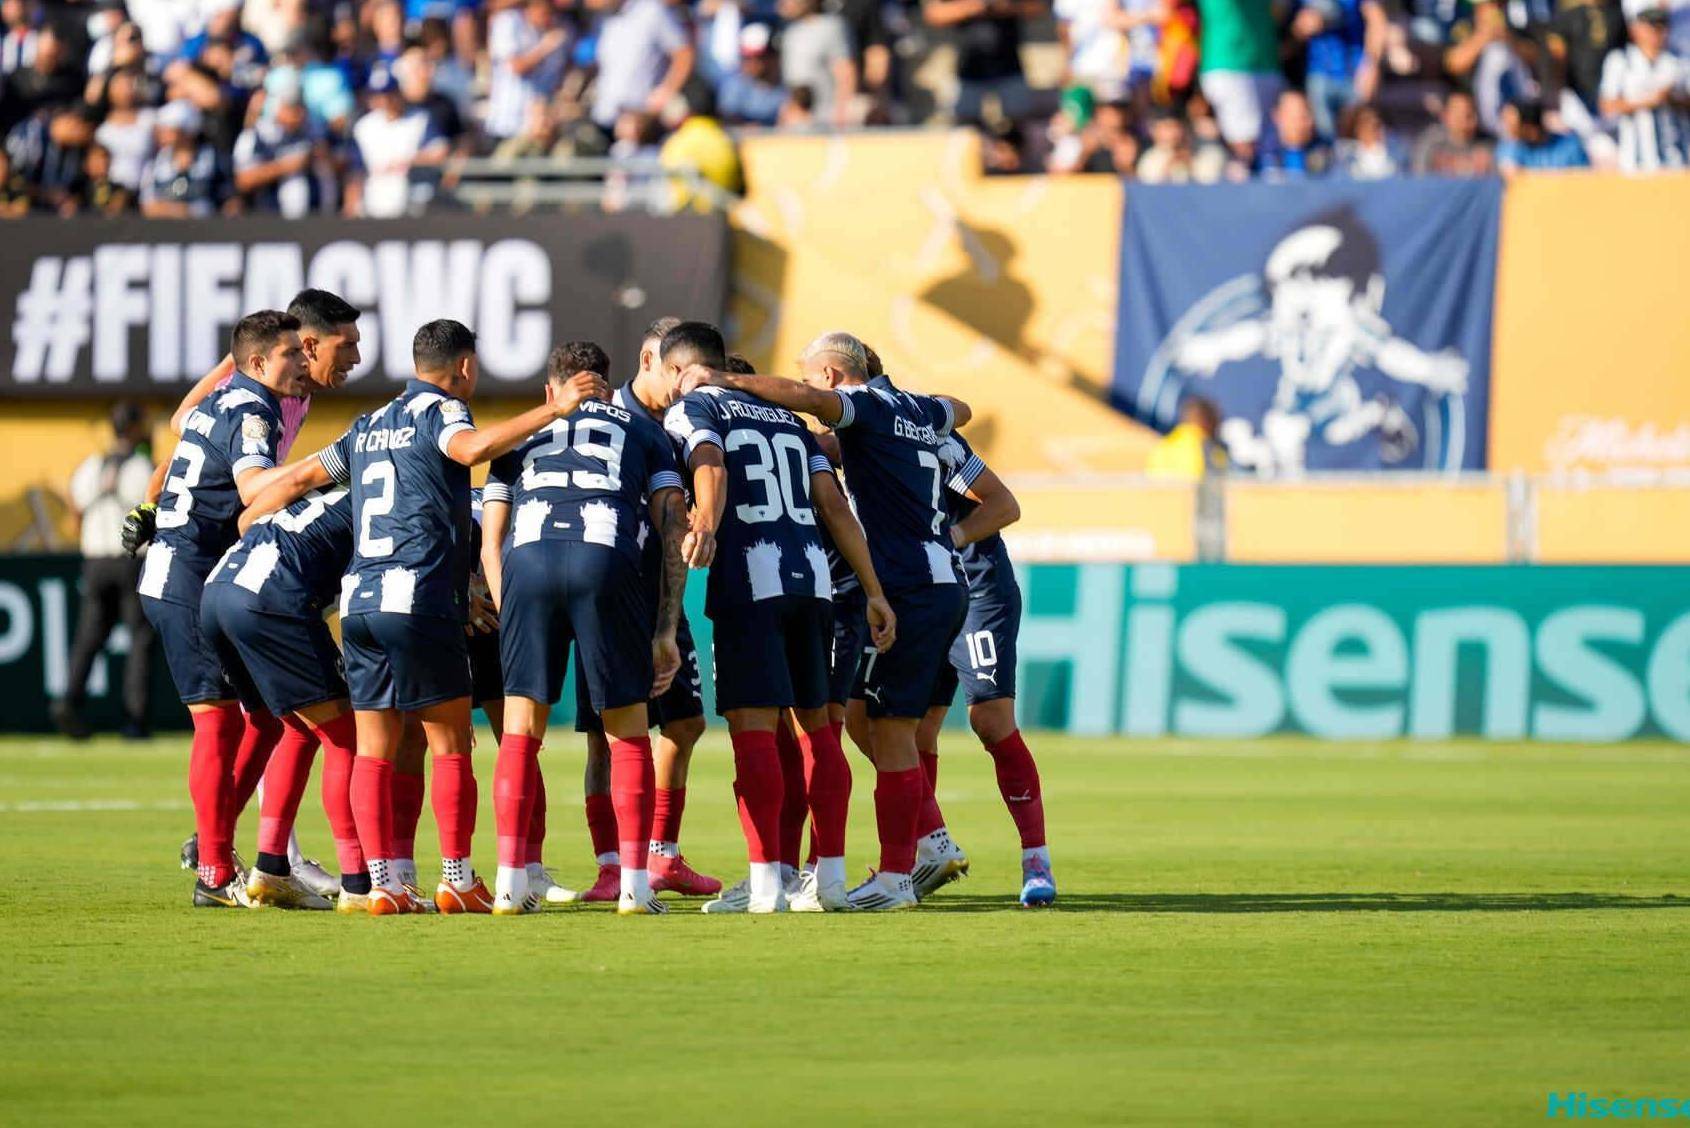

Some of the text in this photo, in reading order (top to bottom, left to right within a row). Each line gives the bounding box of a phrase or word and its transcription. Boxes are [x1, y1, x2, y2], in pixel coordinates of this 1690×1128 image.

[521, 417, 626, 492] 29
[725, 428, 817, 526] 30
[917, 449, 946, 536] 7
[358, 460, 395, 558] 2
[864, 646, 879, 683] 7
[965, 629, 998, 669] 10
